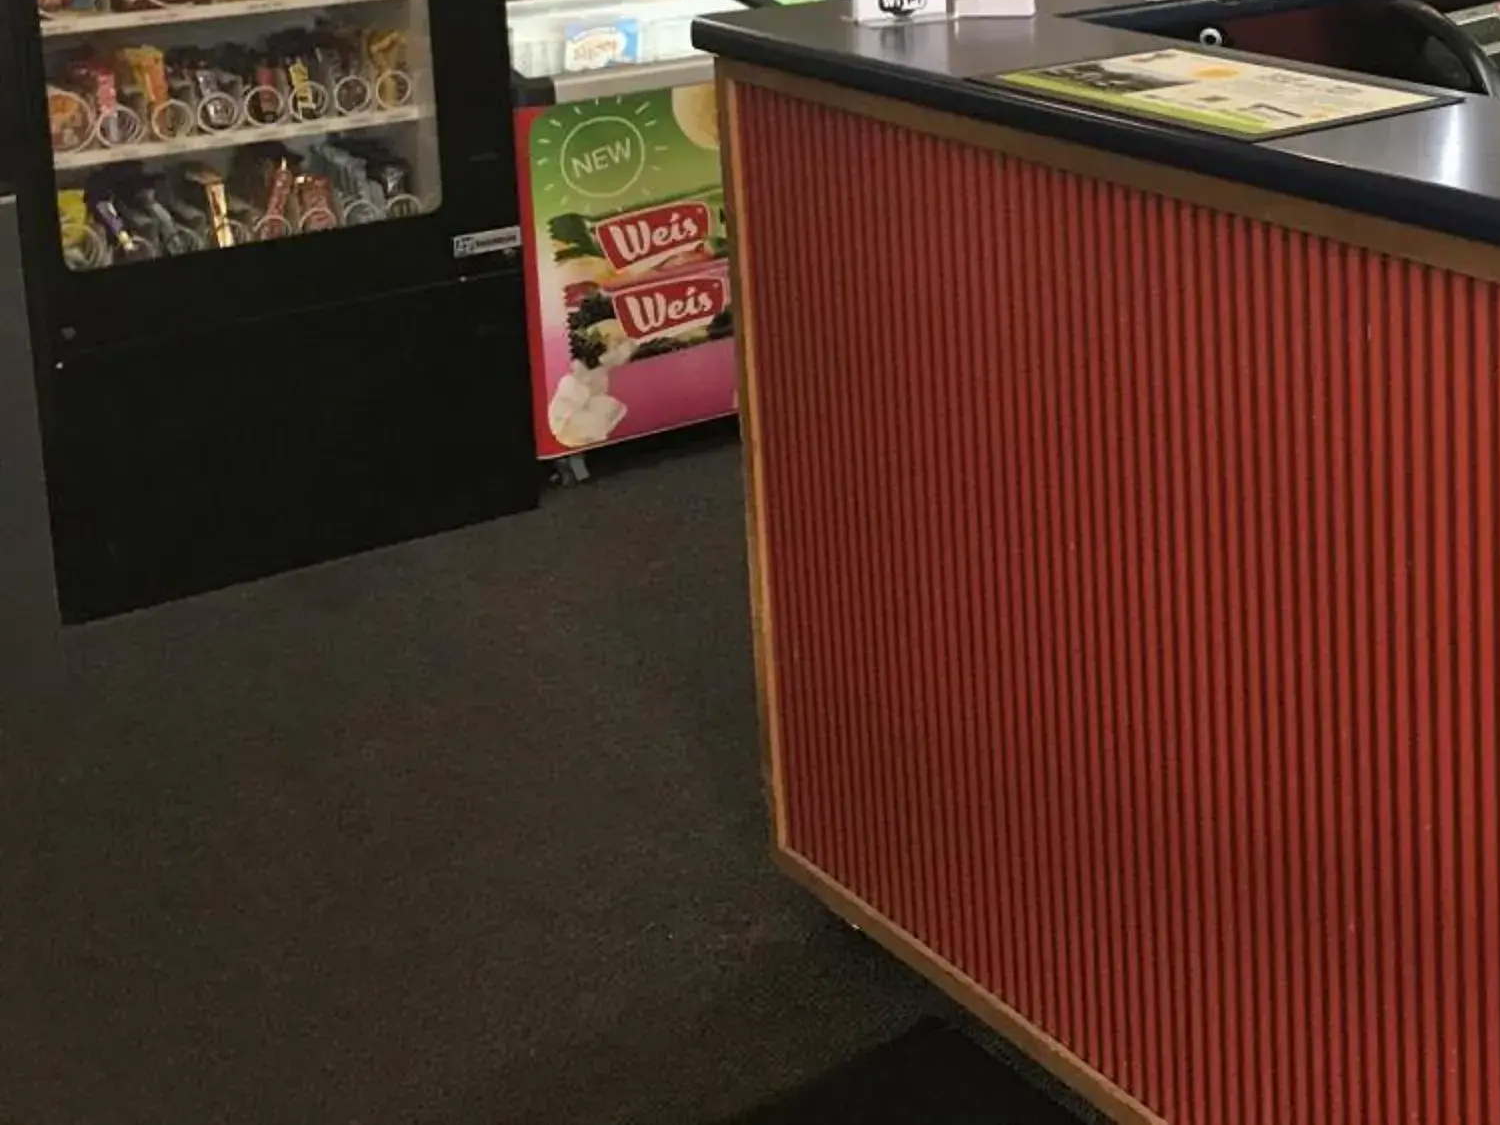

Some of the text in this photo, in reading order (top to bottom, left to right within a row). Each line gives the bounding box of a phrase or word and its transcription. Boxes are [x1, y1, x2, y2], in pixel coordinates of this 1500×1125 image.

[572, 137, 631, 178] NEW
[608, 212, 698, 261] Weis
[624, 286, 713, 333] Weis
